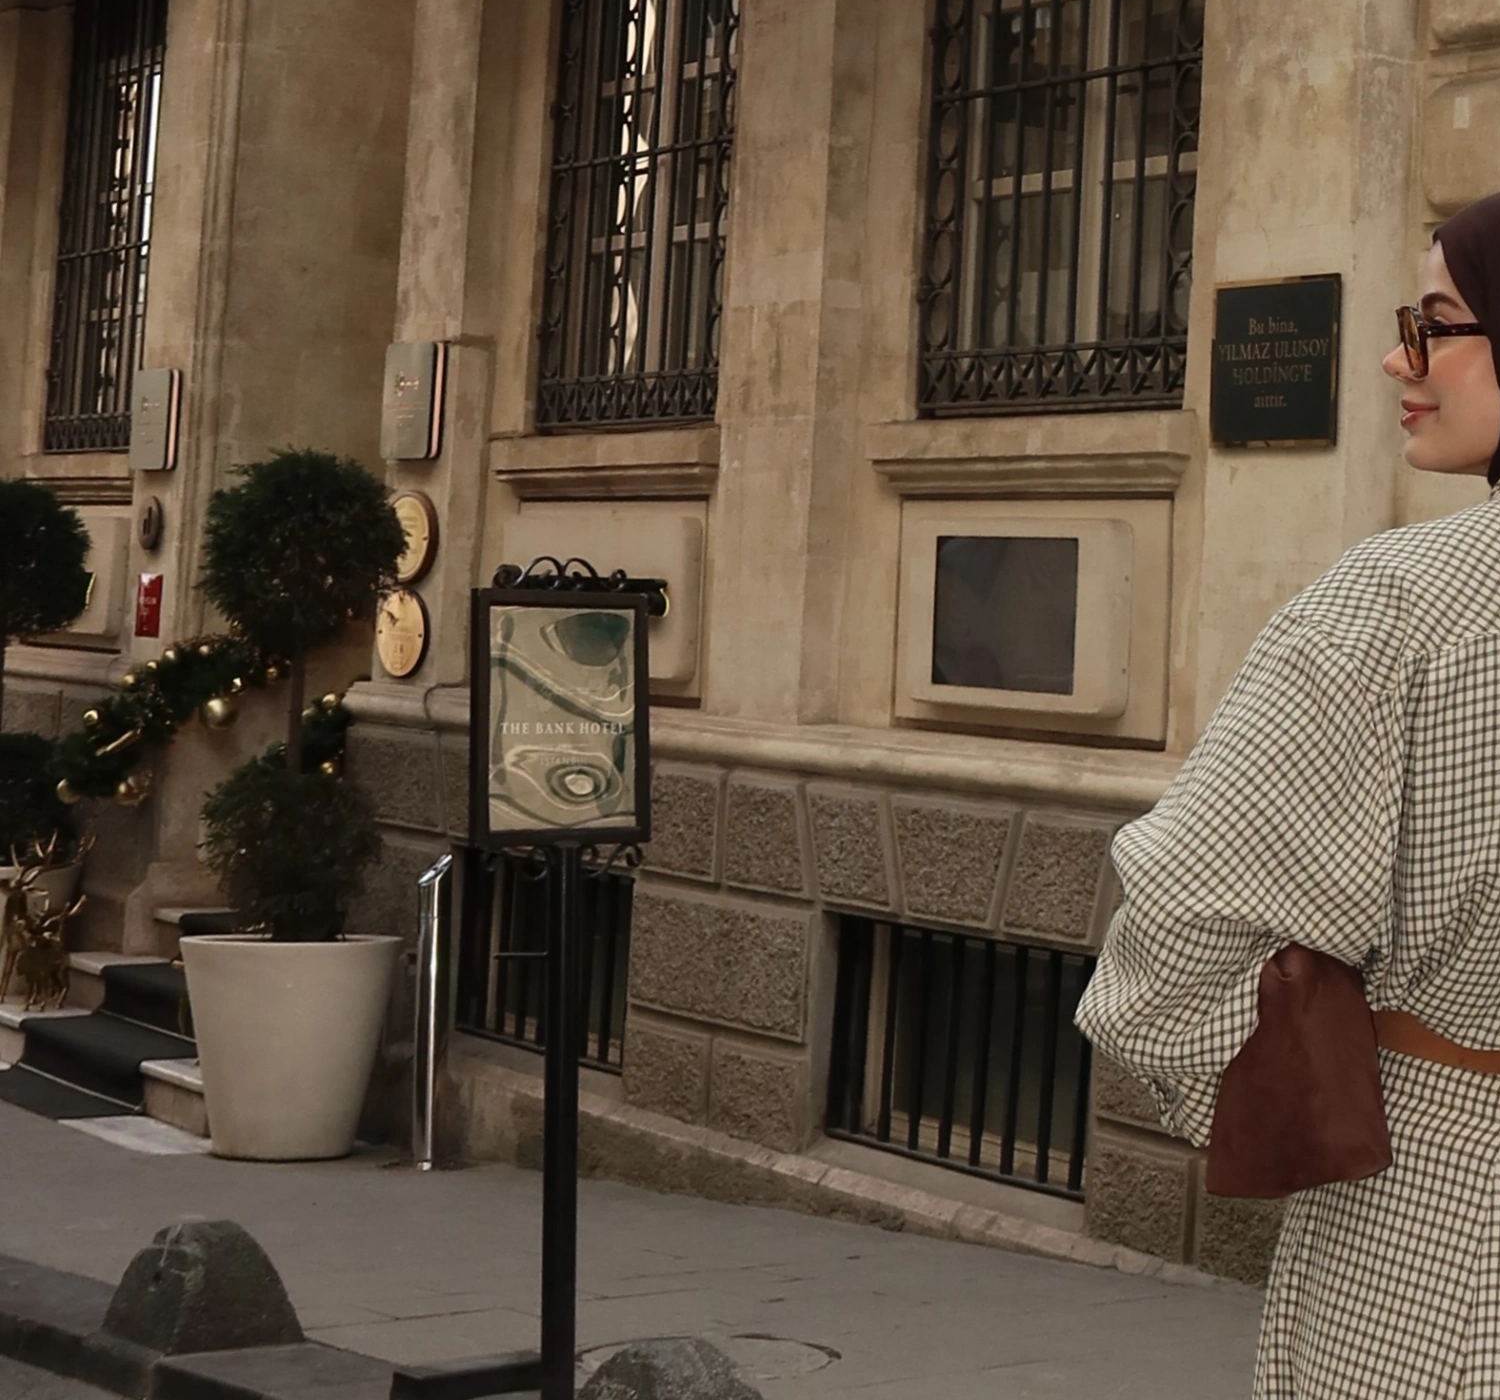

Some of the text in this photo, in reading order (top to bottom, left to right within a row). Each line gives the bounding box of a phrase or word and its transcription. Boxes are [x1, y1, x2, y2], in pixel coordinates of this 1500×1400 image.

[1248, 316, 1299, 336] Bu bina,
[1218, 338, 1330, 362] YILMAZ ULUSOY
[500, 722, 626, 735] THE BANK HOTEL
